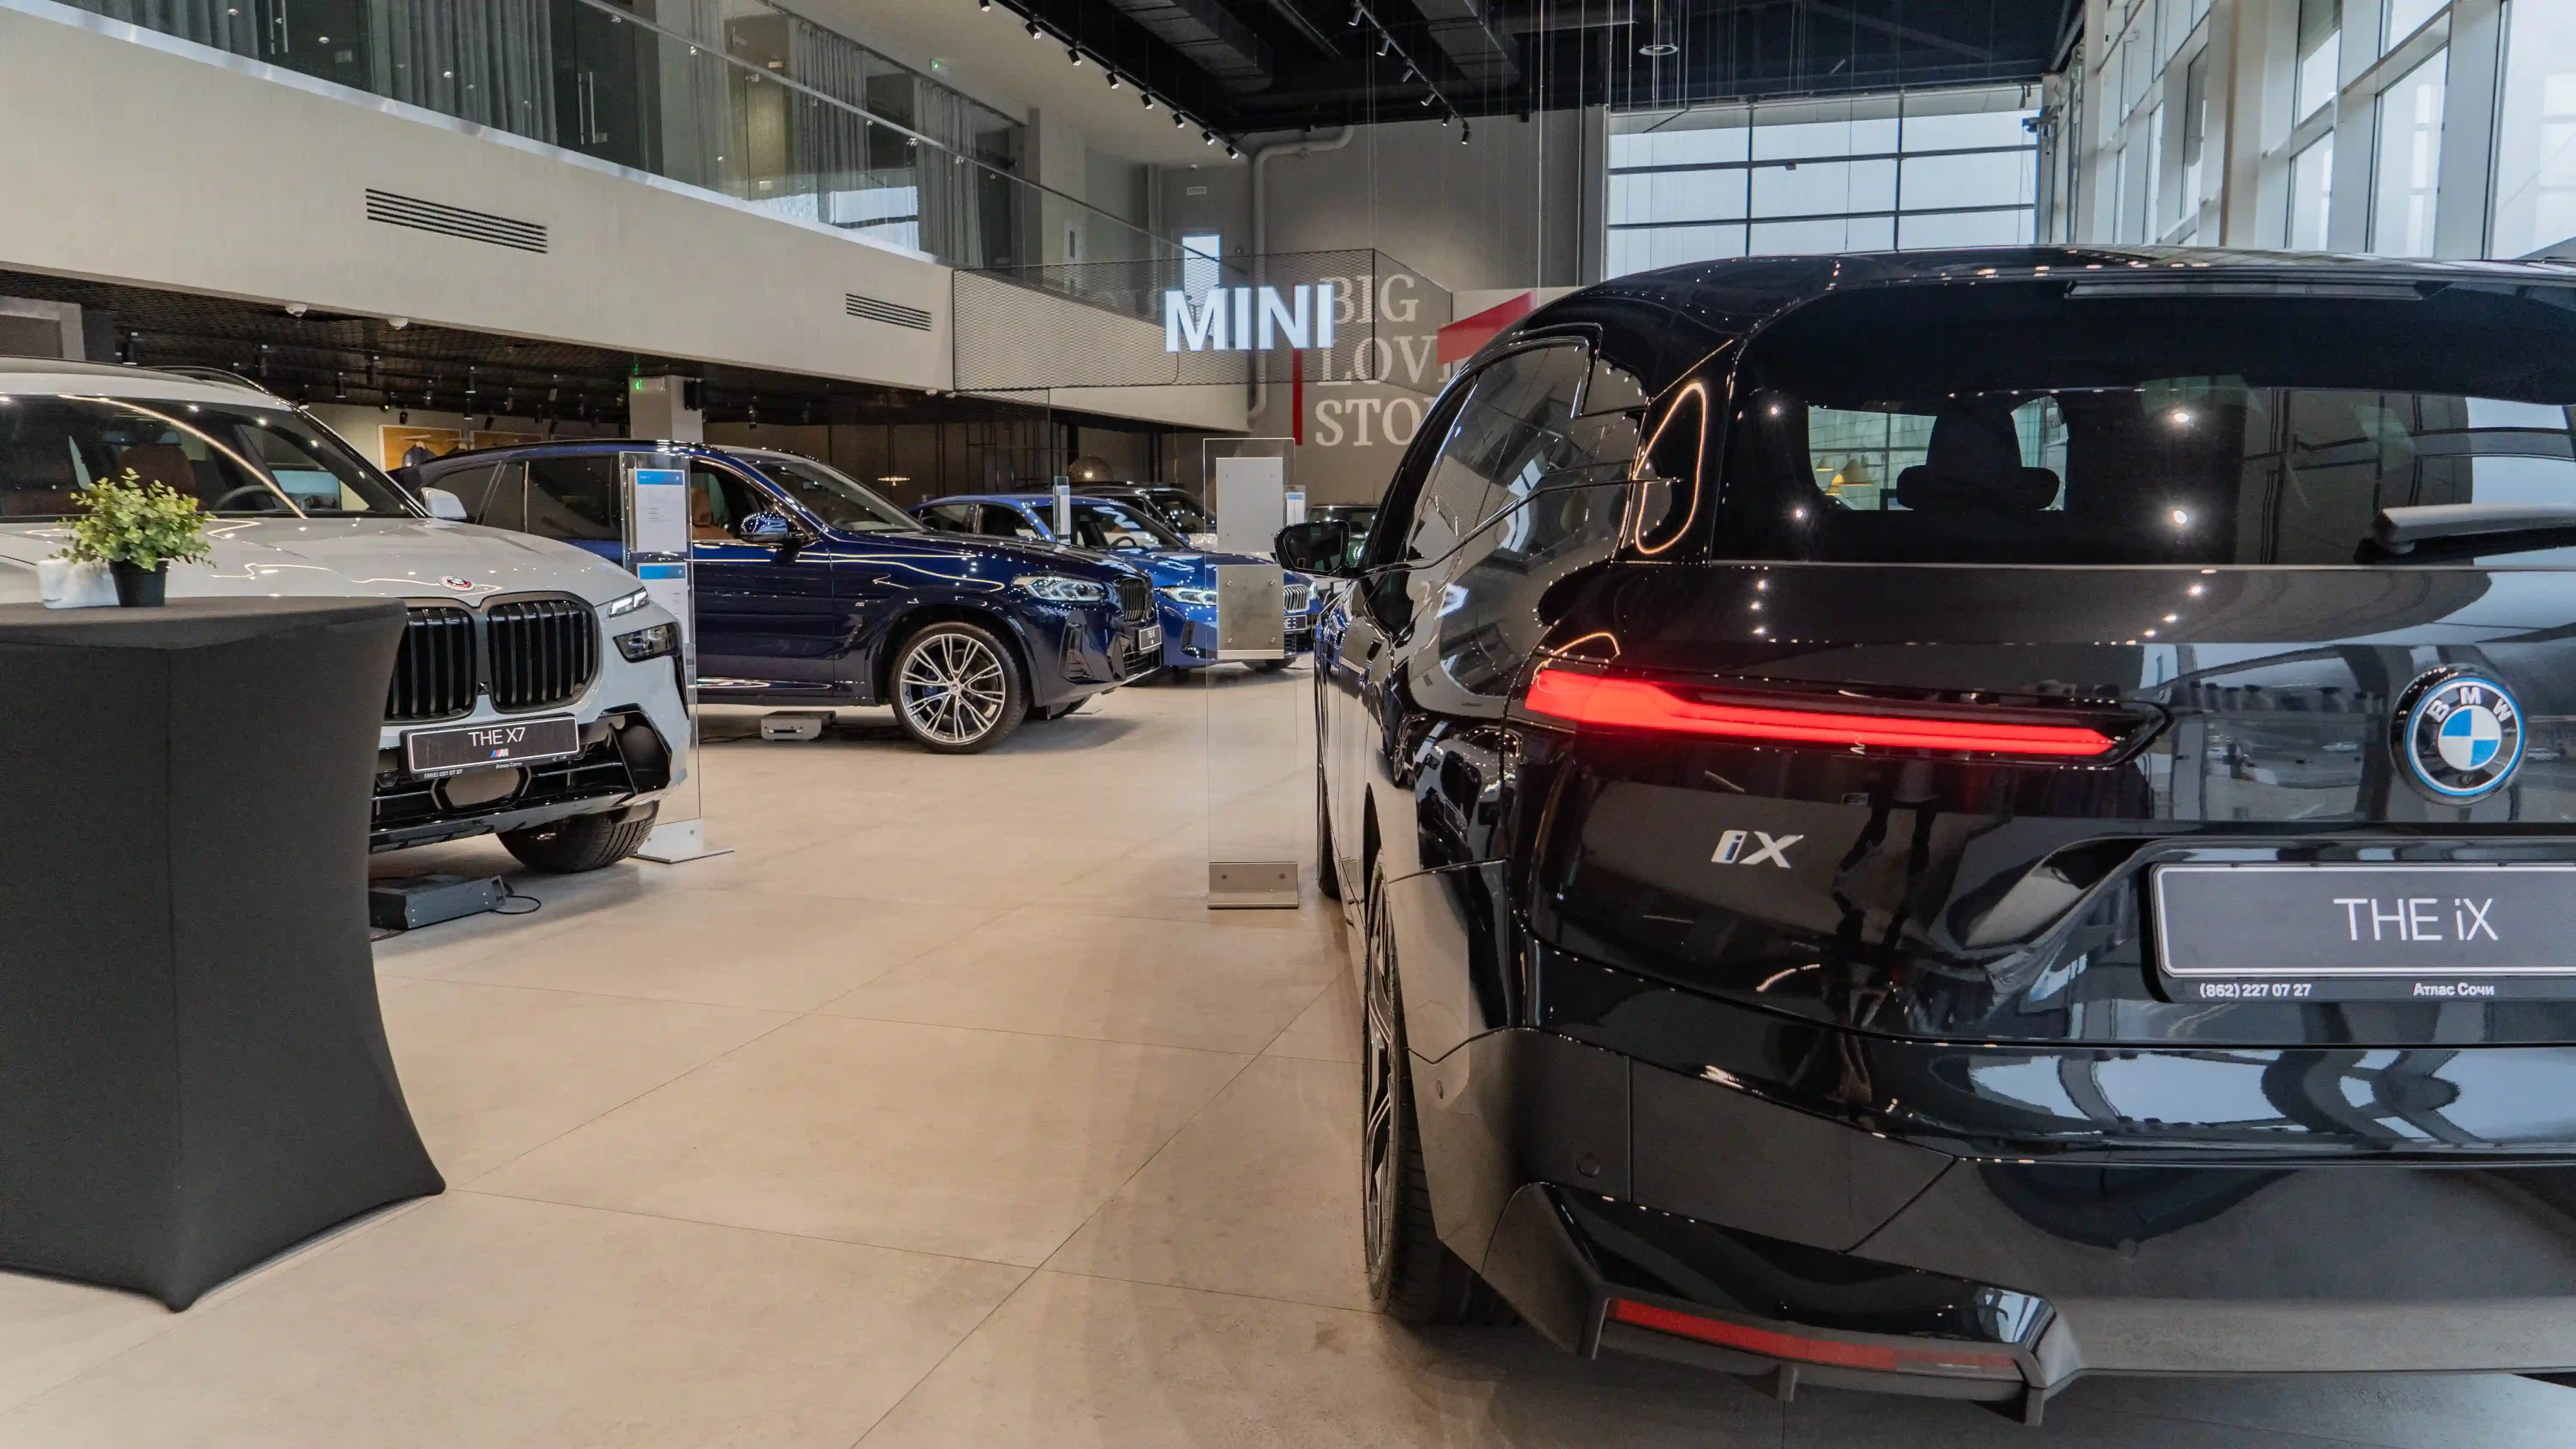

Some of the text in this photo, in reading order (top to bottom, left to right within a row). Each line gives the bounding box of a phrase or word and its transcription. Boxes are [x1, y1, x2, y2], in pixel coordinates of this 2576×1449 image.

[1165, 284, 1334, 352] MINI
[1320, 273, 1419, 324] BIG
[1316, 335, 1449, 386] LOV
[1315, 397, 1437, 447] STO
[2427, 687, 2512, 723] BMW
[468, 727, 526, 747] THE X7
[1711, 830, 1804, 869] iX
[2333, 898, 2498, 941] THE iX
[2199, 983, 2312, 998] (862) 227 07 27
[2413, 982, 2494, 996] Атлас Сочи
